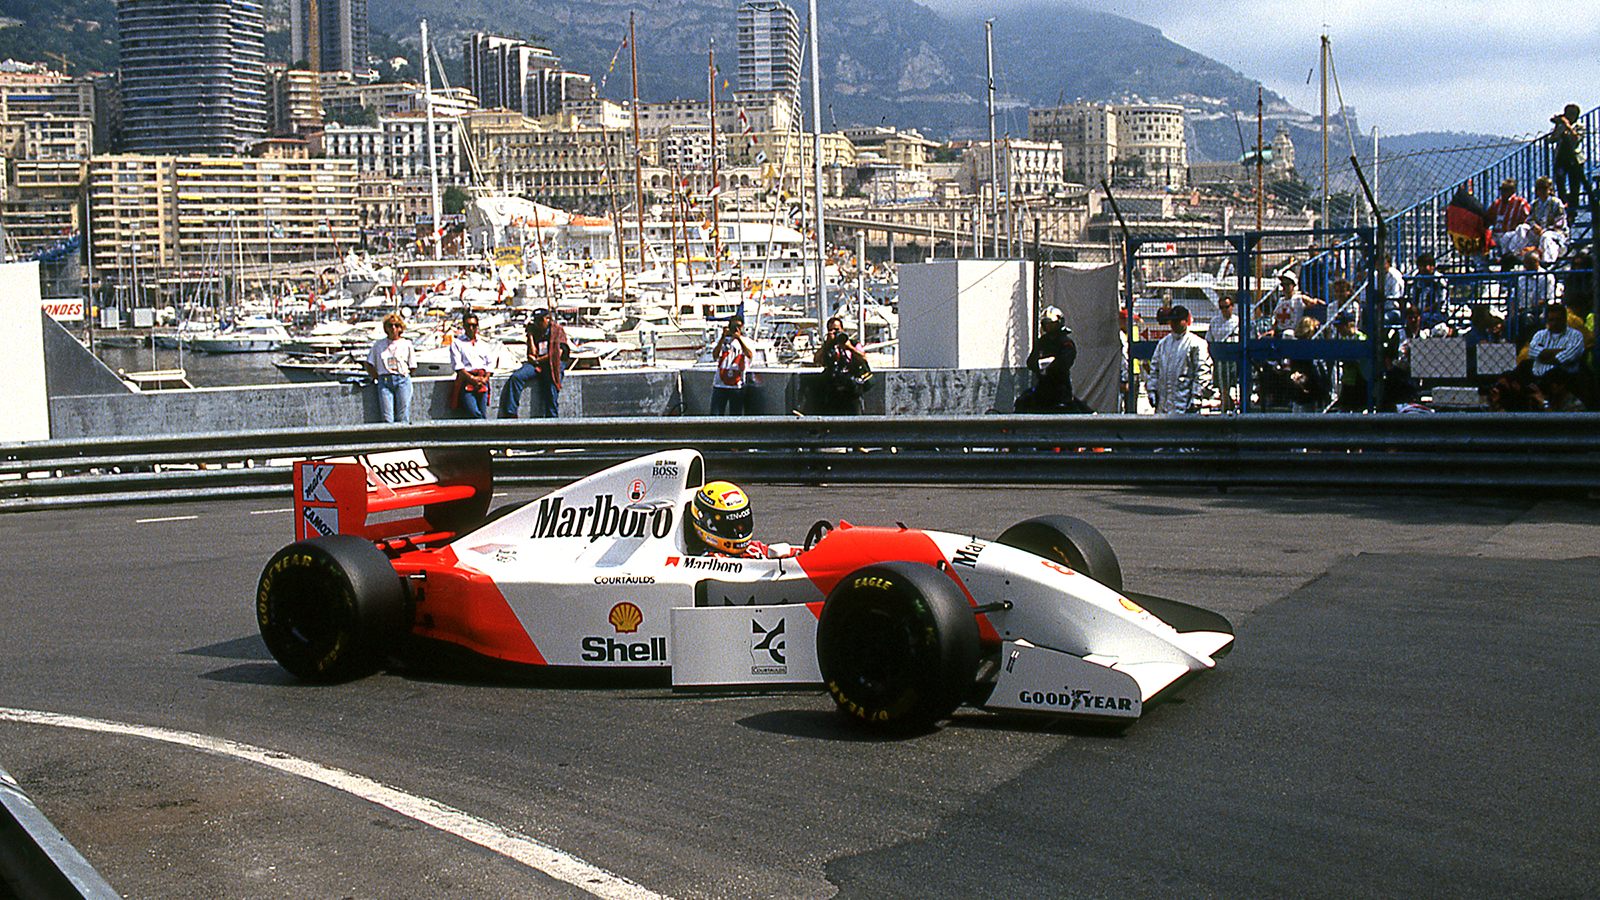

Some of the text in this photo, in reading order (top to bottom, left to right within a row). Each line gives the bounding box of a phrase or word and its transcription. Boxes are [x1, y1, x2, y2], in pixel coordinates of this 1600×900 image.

[42, 303, 83, 316] ONDES
[652, 466, 679, 477] BOSS
[633, 482, 641, 493] E
[530, 494, 673, 539] Marlboro
[683, 556, 743, 574] Marlboro
[594, 576, 656, 585] COURTAULDS
[853, 576, 893, 591] EAGLE
[581, 636, 667, 662] Shell
